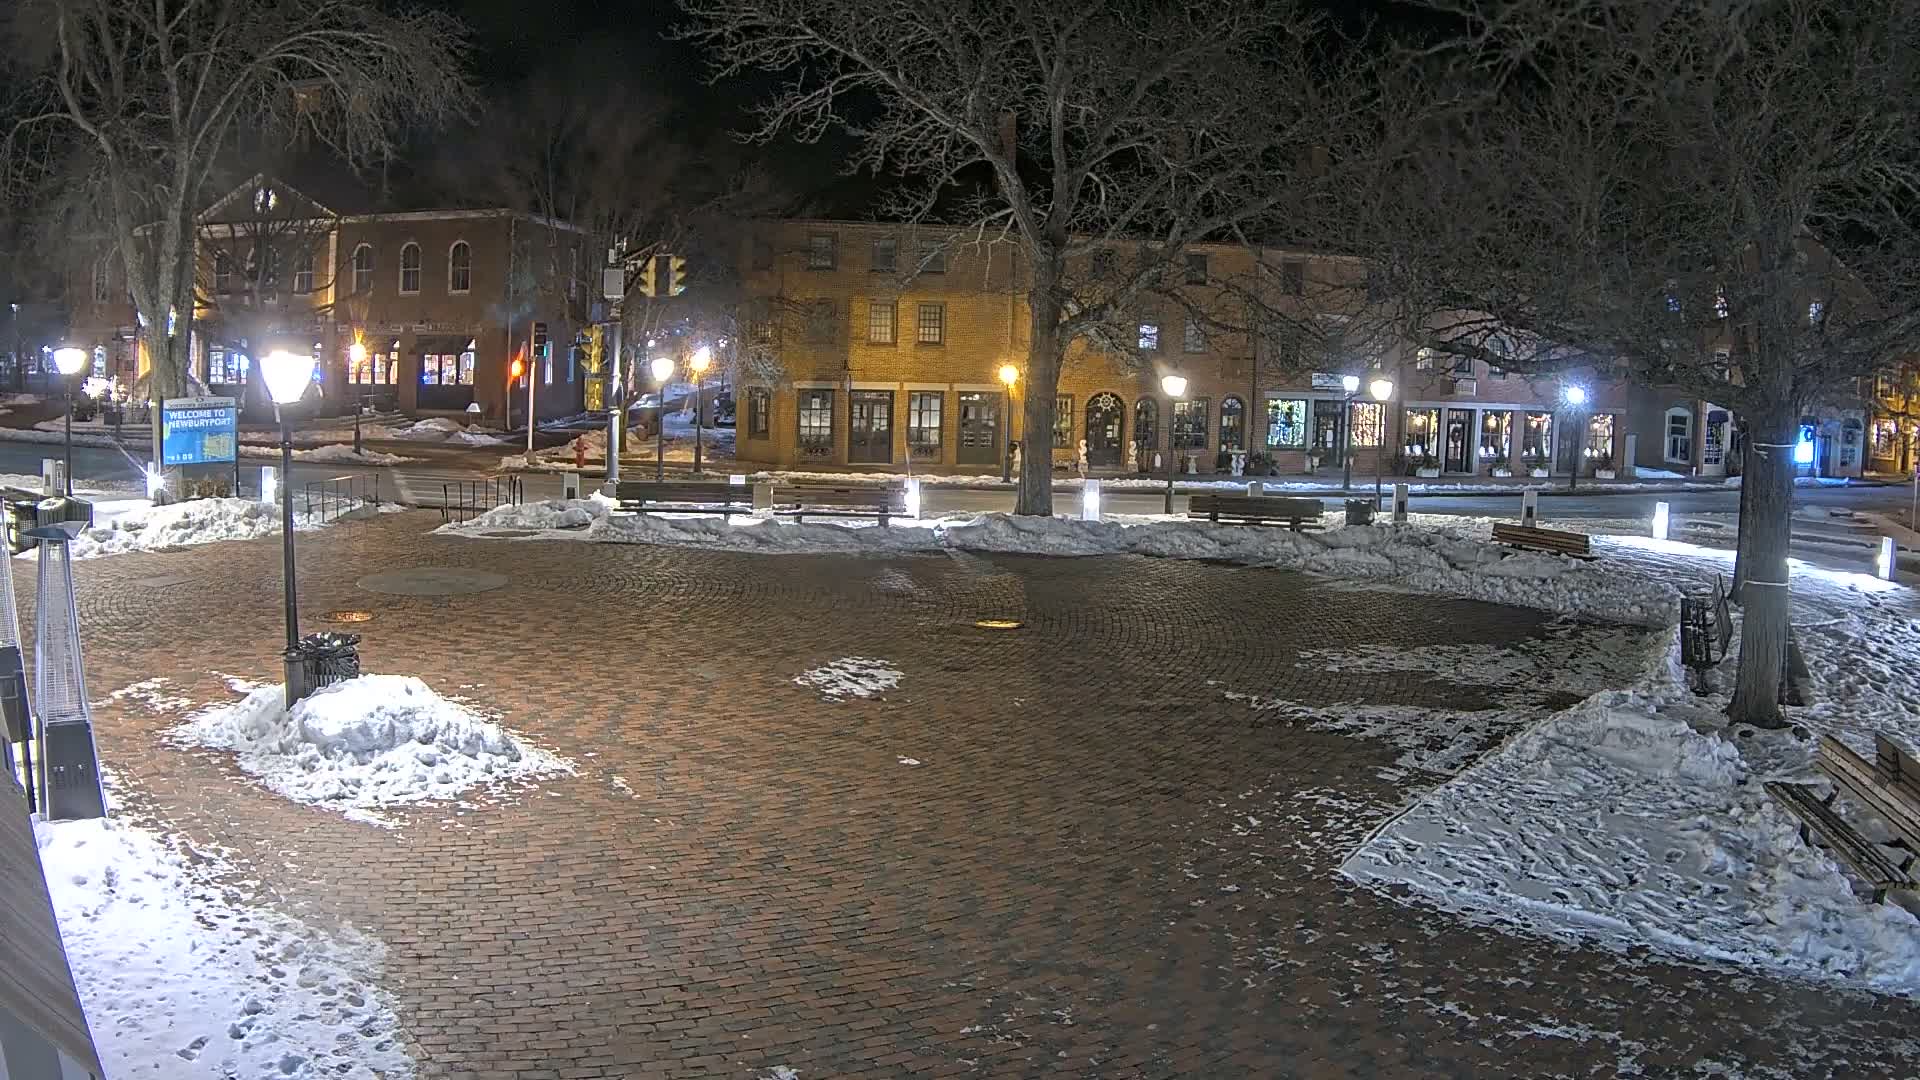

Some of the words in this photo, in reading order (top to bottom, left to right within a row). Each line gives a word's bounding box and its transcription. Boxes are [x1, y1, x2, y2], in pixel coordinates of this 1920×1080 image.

[169, 410, 212, 419] WELCOME
[213, 409, 226, 418] TO
[168, 418, 231, 428] NEWBURYPORT
